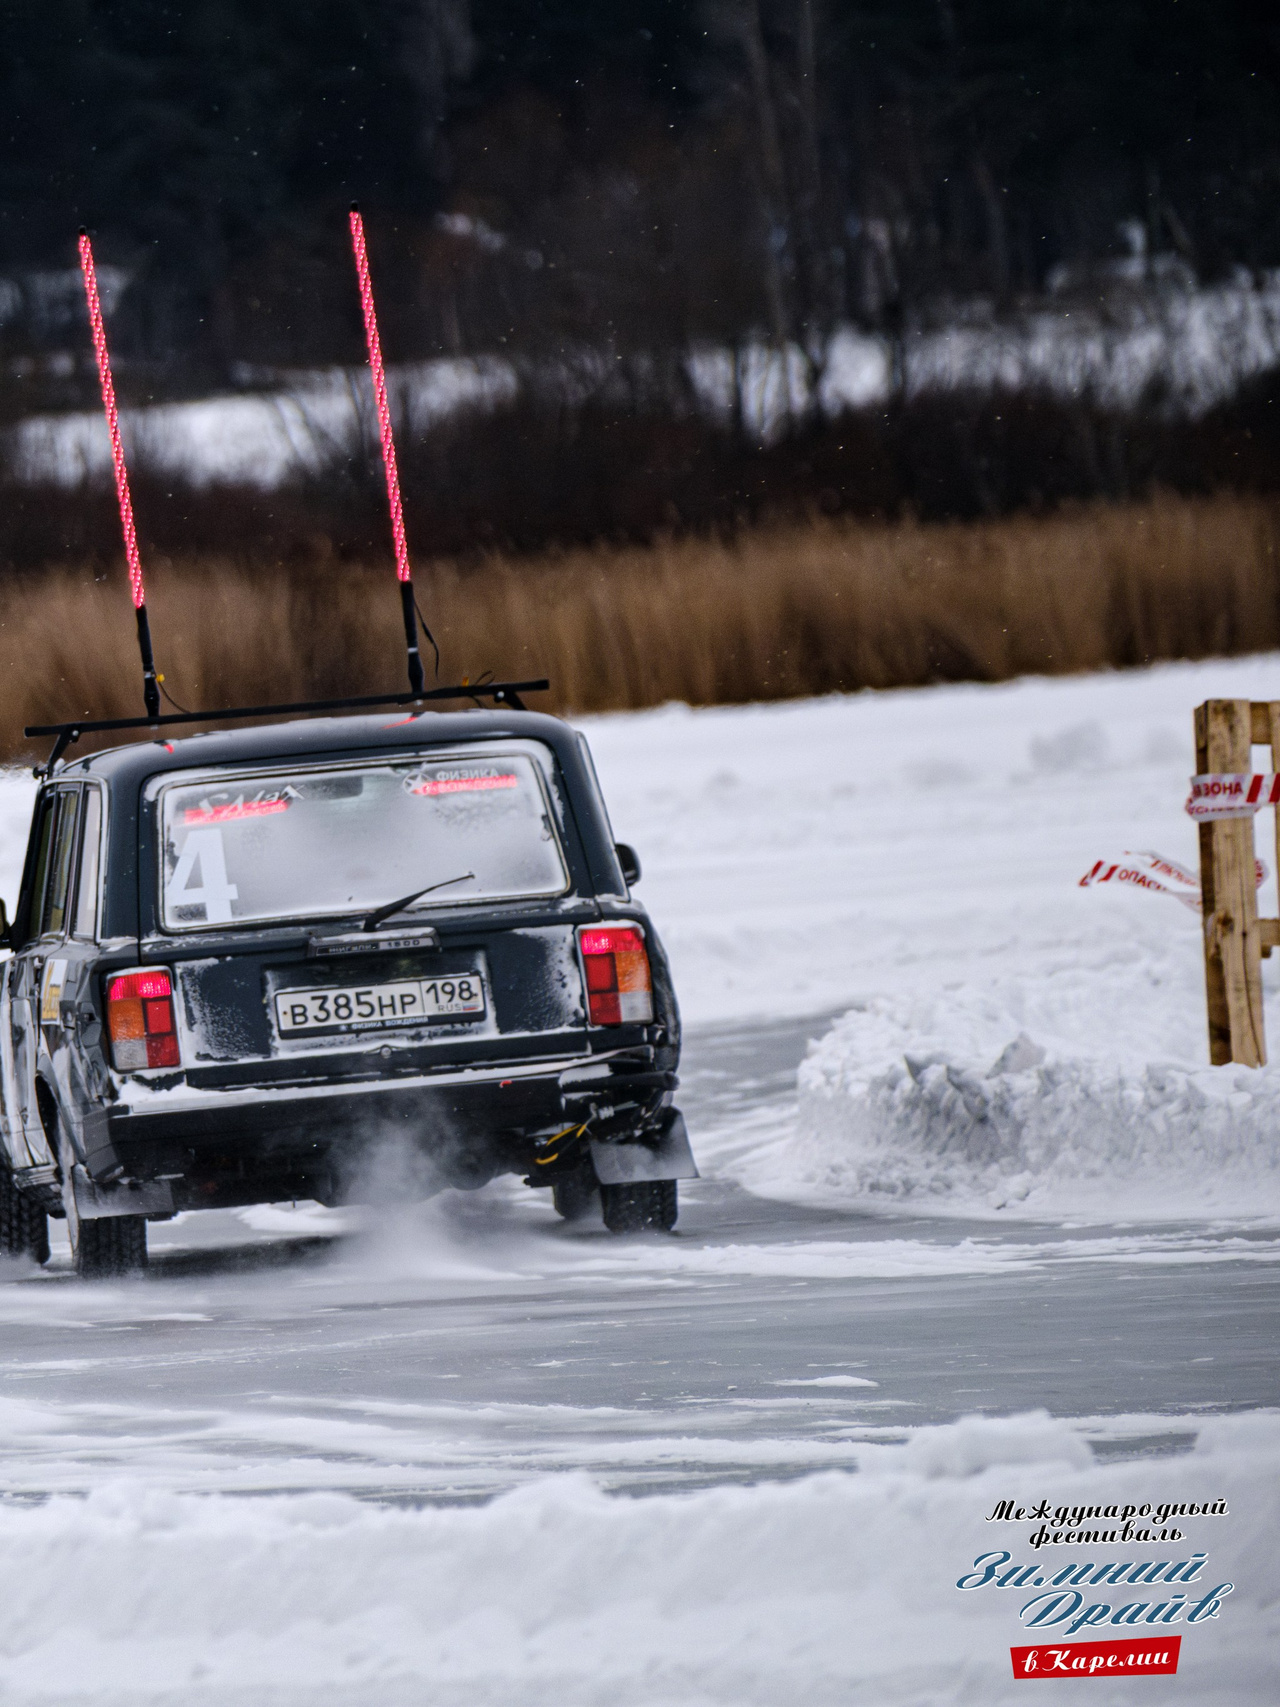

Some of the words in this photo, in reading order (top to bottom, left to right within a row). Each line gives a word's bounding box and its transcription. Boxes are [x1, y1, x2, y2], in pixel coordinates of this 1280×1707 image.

[1202, 781, 1244, 797] ЗОНА
[165, 828, 239, 921] 4
[289, 990, 417, 1026] В385НР
[425, 980, 473, 1004] 198
[437, 1003, 463, 1012] RUS
